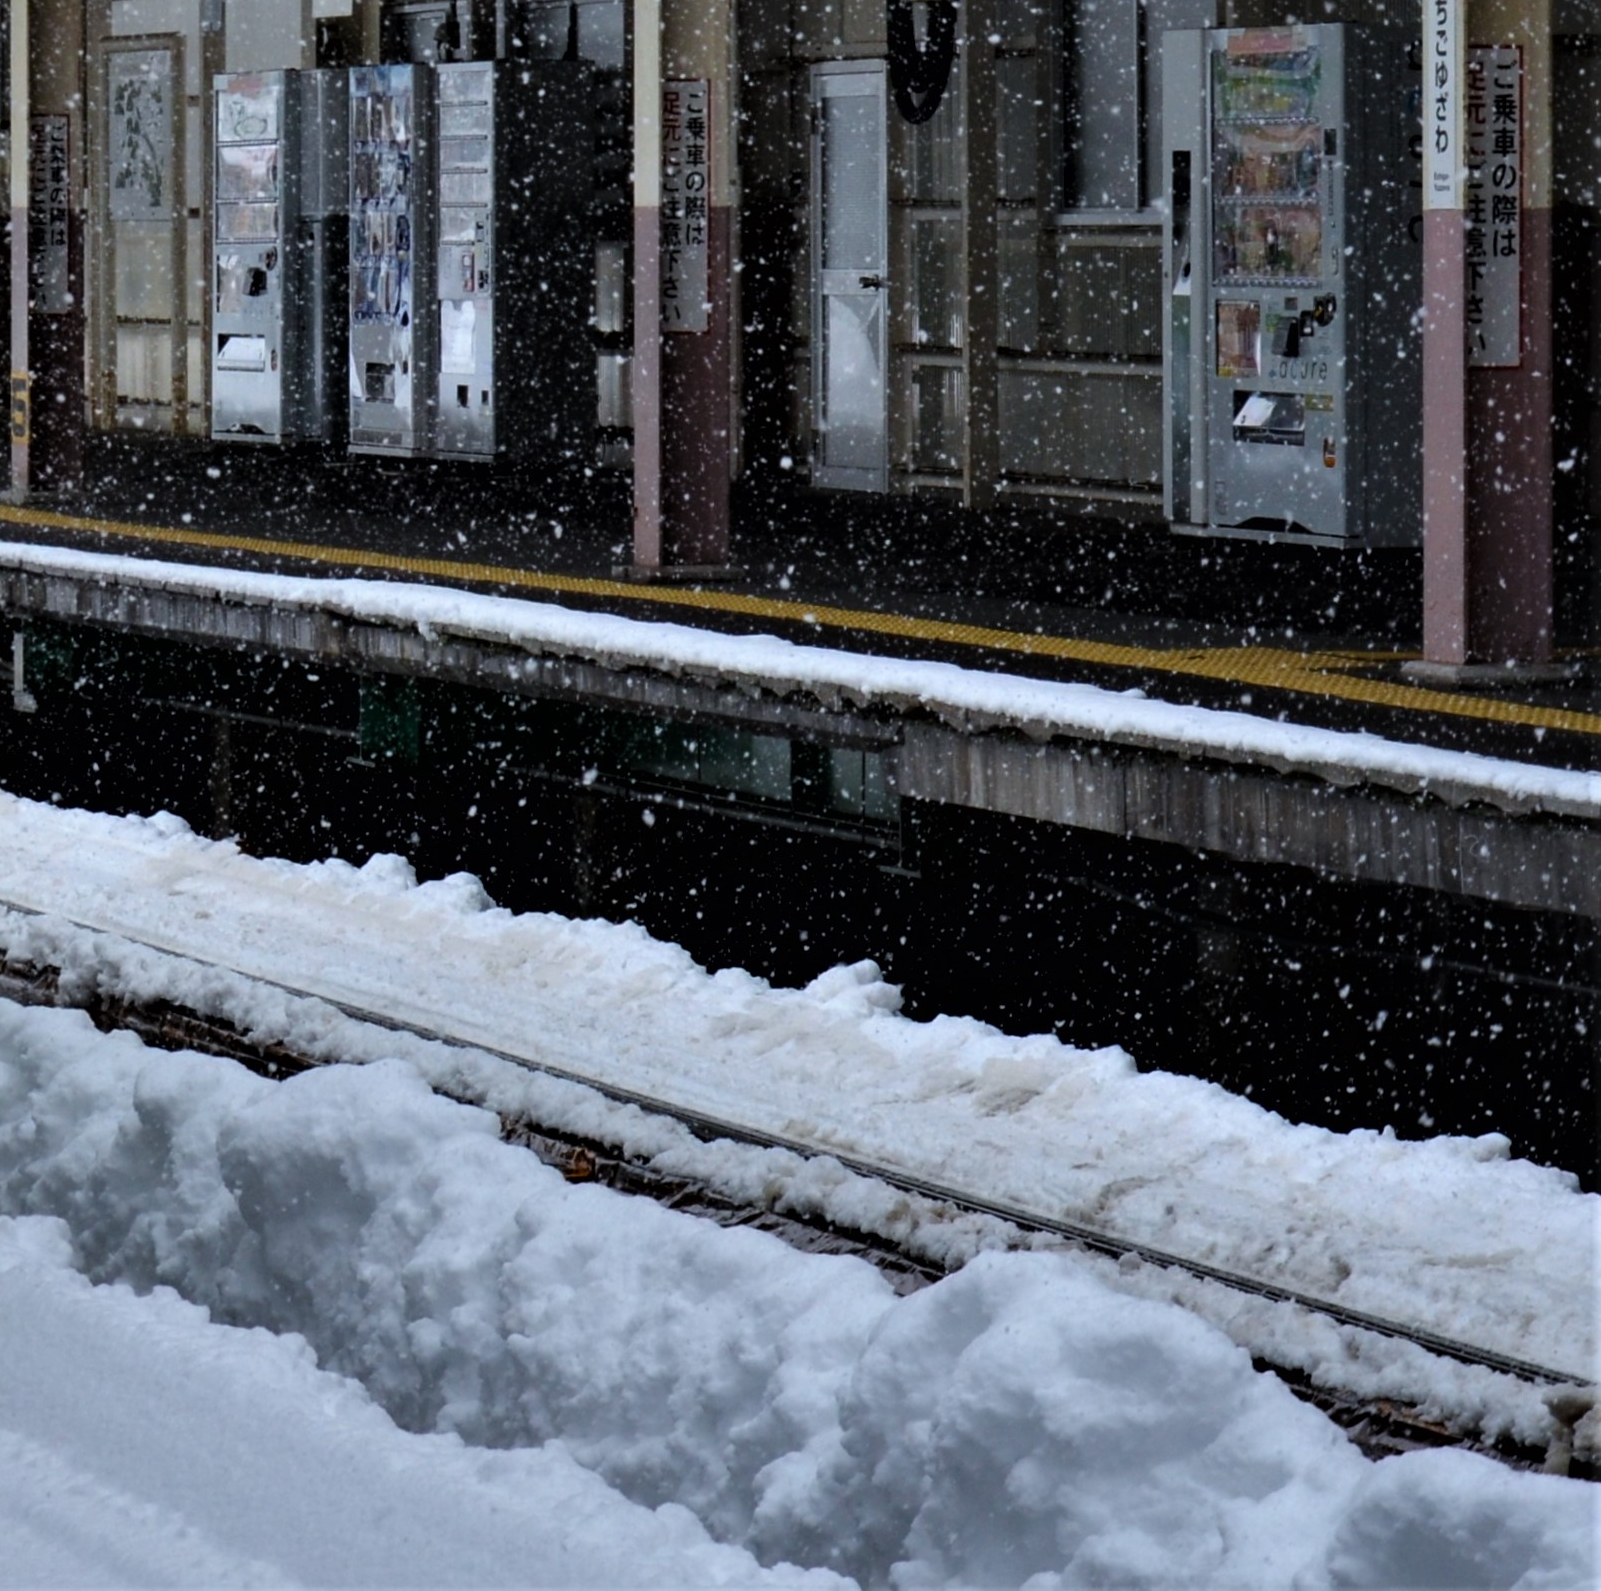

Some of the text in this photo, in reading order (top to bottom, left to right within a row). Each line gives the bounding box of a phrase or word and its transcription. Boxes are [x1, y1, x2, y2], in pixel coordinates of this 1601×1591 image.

[662, 91, 682, 323] 足元にご注意下さい
[685, 90, 706, 247] ご乗車の際は
[1492, 61, 1518, 259] ご乗車の際は
